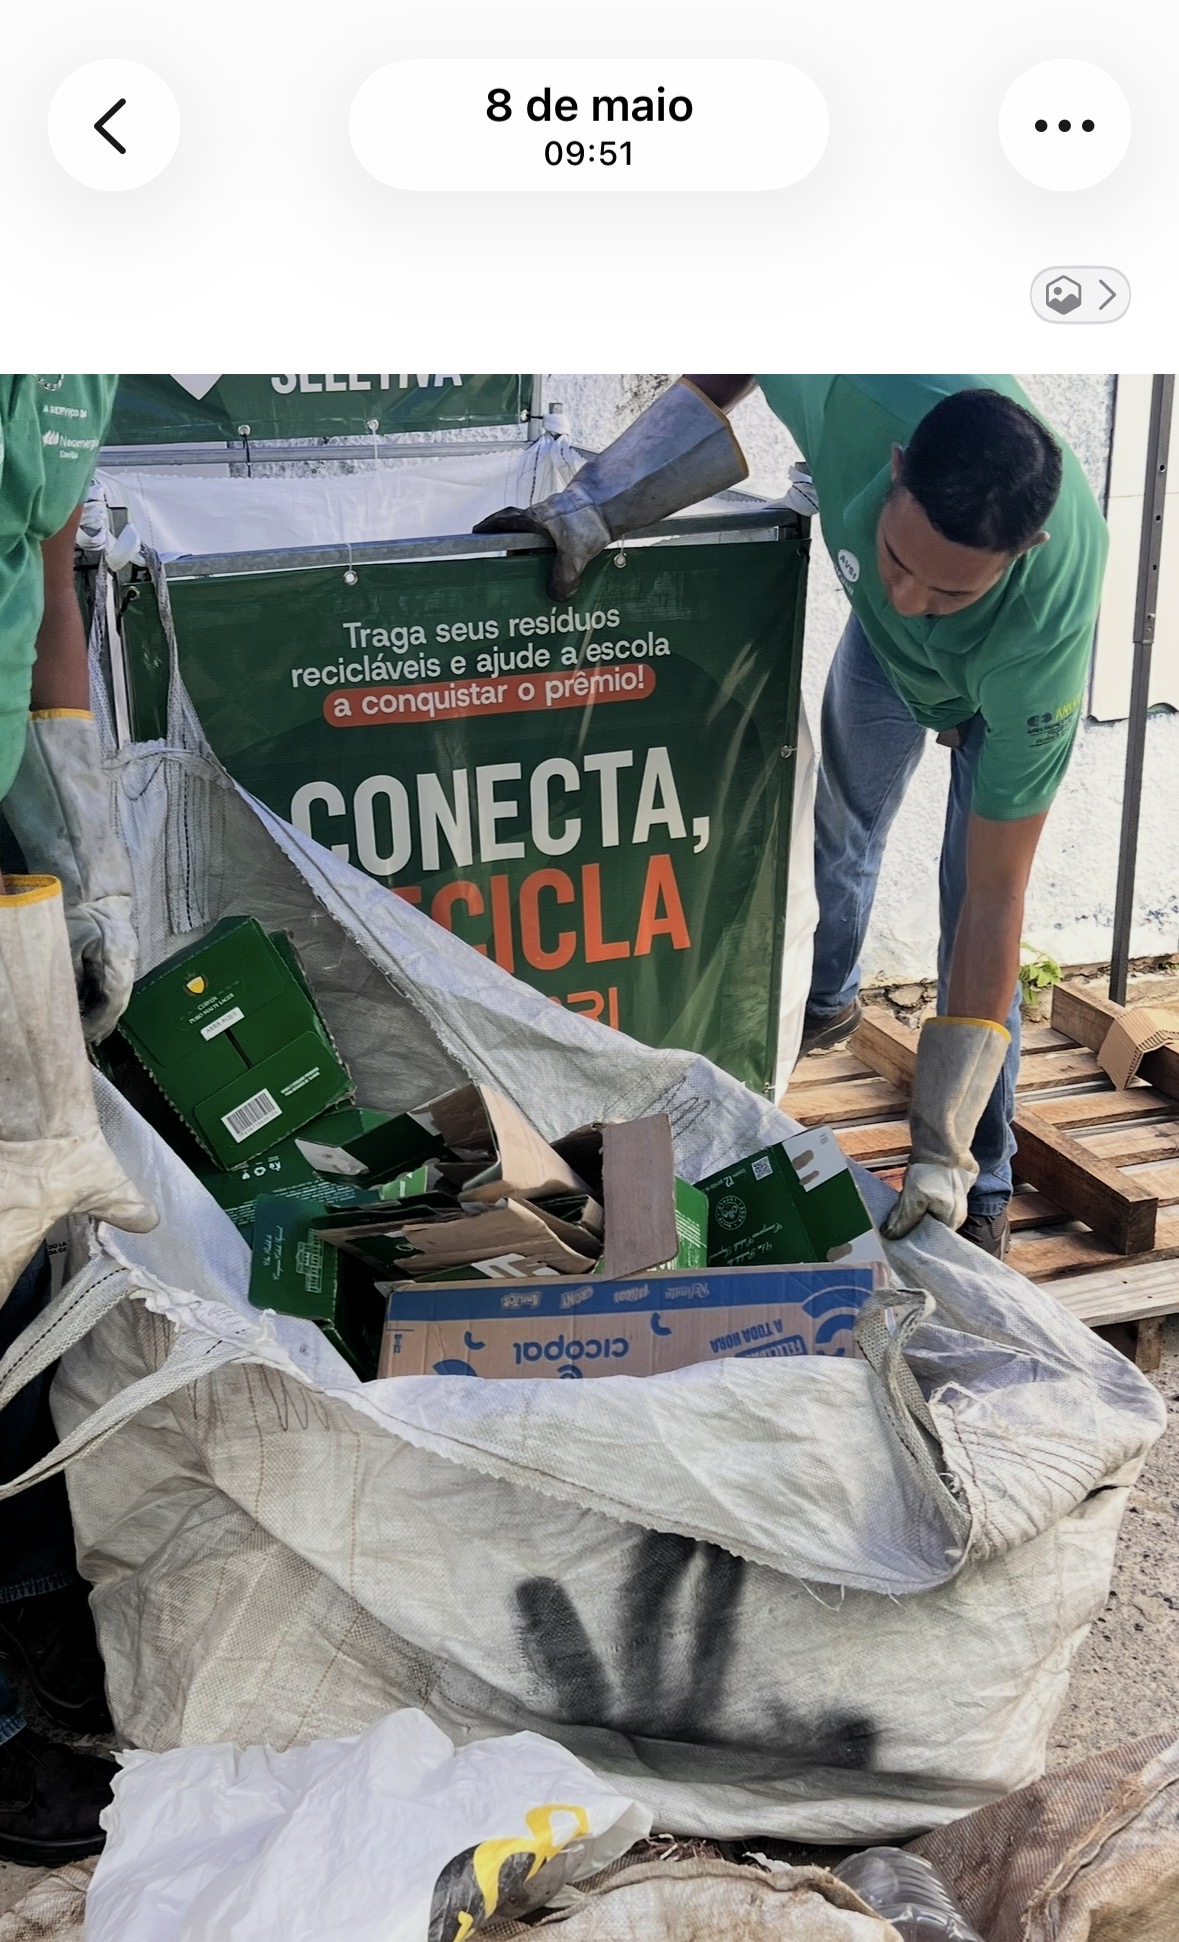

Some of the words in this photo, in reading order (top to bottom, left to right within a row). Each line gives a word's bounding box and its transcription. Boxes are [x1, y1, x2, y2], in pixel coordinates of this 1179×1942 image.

[343, 621, 427, 654] Traga
[435, 618, 500, 643] seus
[508, 606, 621, 638] resíduos
[291, 653, 442, 688] recicláveis
[449, 655, 467, 675] e
[476, 642, 551, 679] ajude
[560, 644, 579, 666] a
[585, 631, 671, 663] escola
[332, 697, 352, 718] a
[360, 679, 508, 718] conquistar
[517, 680, 536, 702] o
[544, 664, 645, 706] prêmio!
[290, 745, 710, 877] CONECTA,
[389, 853, 692, 975] CICLA
[512, 1334, 630, 1365] cicopal
[709, 1331, 742, 1354] HORA
[741, 1322, 774, 1343] TODA
[773, 1319, 783, 1333] A
